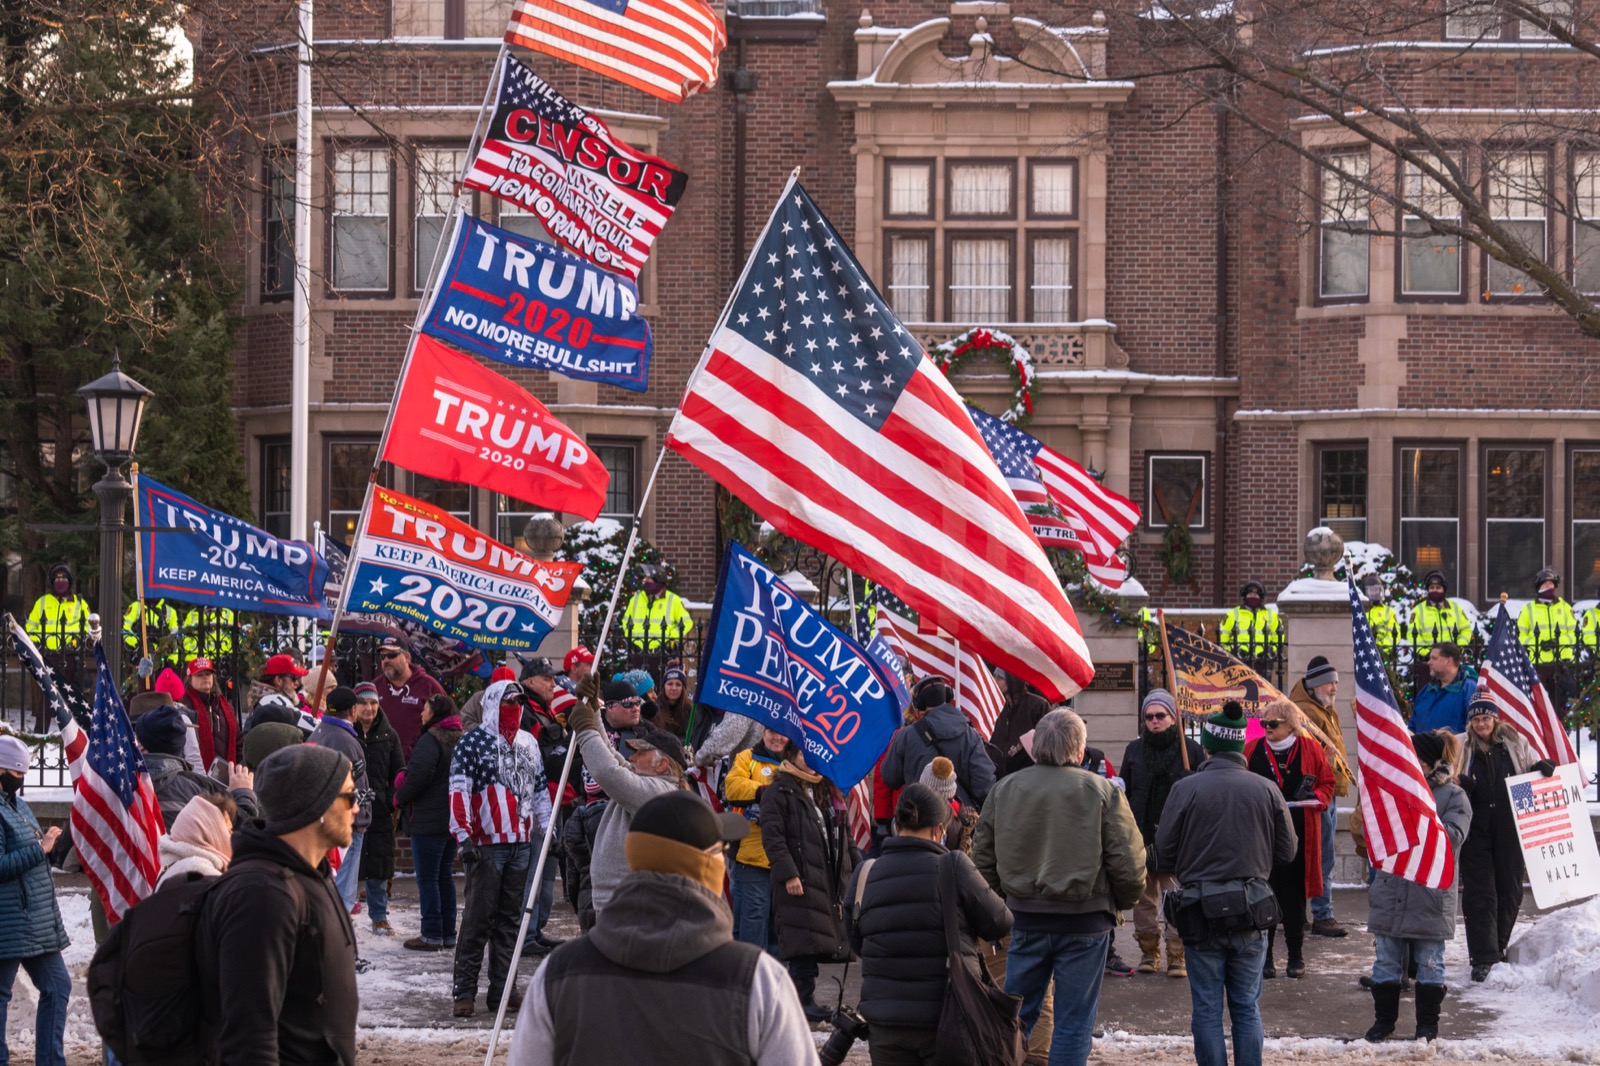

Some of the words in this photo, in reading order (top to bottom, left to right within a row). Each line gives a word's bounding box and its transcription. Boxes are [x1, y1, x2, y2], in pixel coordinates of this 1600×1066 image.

[515, 65, 522, 77] I
[524, 70, 569, 109] WILL
[569, 106, 609, 136] NOT
[504, 108, 673, 204] CENSOR
[490, 174, 627, 271] IGNORANCE
[507, 150, 530, 174] TO
[590, 211, 634, 252] YOUR
[565, 164, 647, 230] MYSELF
[476, 224, 637, 321] TRUMP
[444, 305, 478, 330] NO
[476, 319, 535, 354] MORE
[533, 338, 636, 375] BULLSHIT
[502, 291, 593, 349] 2020
[433, 388, 589, 471] TRUMP
[479, 446, 525, 471] 2020
[383, 504, 566, 592] TRUMP
[1033, 526, 1052, 536] N'T
[1055, 528, 1078, 540] TRE
[158, 567, 197, 581] KEEP
[200, 573, 265, 592] AMERICA
[375, 544, 423, 565] KEEP
[426, 556, 494, 592] AMERICA
[499, 583, 553, 618] GREAT!
[393, 574, 517, 633] 2020
[362, 600, 380, 610] For
[384, 601, 429, 623] President
[432, 619, 447, 631] Of
[451, 626, 469, 638] The
[473, 633, 498, 645] United
[502, 637, 531, 648] States
[738, 553, 885, 705] TRUMP
[722, 610, 826, 715] PENCE
[874, 641, 907, 691] TRUM
[717, 678, 783, 719] Keeping
[803, 734, 833, 763] reat!
[1177, 697, 1198, 710] ight
[1514, 785, 1582, 816] FREEDOM
[1540, 840, 1575, 860] FROM
[1546, 863, 1580, 883] WALZ
